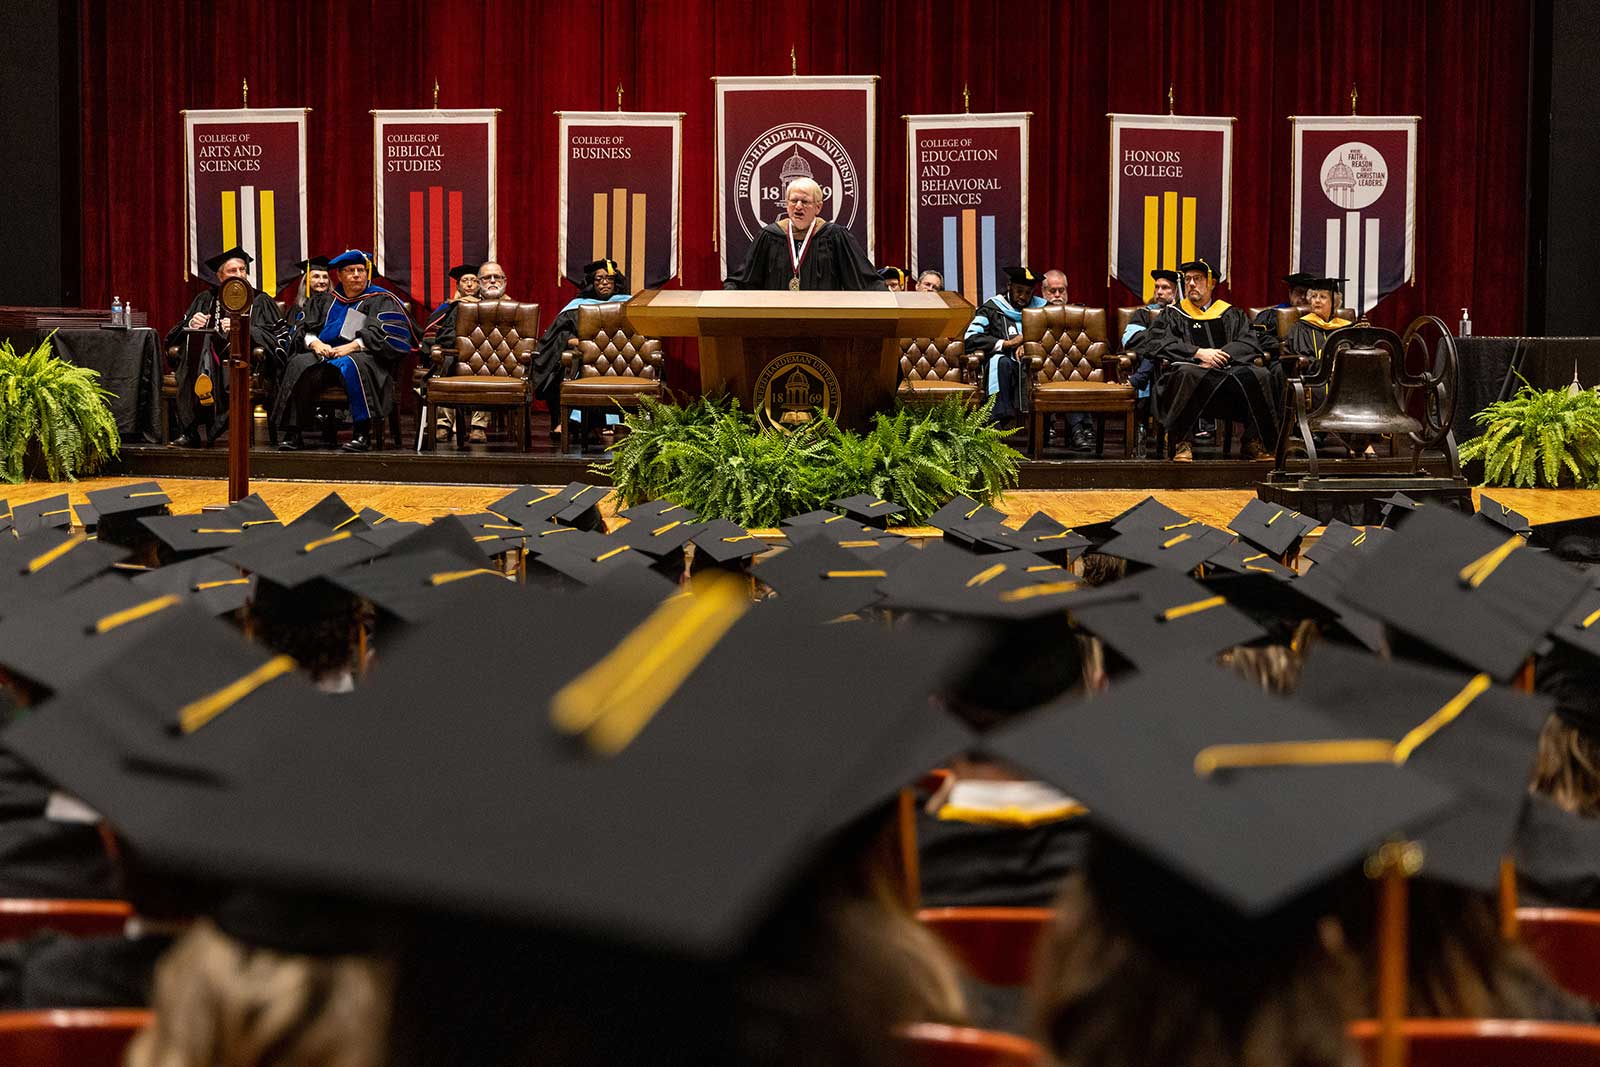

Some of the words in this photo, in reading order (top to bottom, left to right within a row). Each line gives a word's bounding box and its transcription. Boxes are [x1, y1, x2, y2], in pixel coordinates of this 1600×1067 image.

[199, 134, 238, 143] COLLEGE
[239, 134, 250, 142] OF
[387, 134, 427, 143] COLLEGE
[428, 134, 440, 142] OF
[572, 136, 611, 144] COLLEGE
[612, 136, 624, 144] OF
[920, 139, 959, 148] COLLEGE
[960, 138, 973, 147] OF
[200, 146, 231, 157] ARTS
[233, 145, 262, 157] AND
[388, 145, 445, 157] BIBLICAL
[572, 147, 632, 159] BUSINESS
[921, 149, 998, 162] EDUCATION
[1124, 150, 1181, 163] HONORS
[199, 160, 260, 172] SCIENCES
[387, 160, 441, 172] STUDIES
[739, 128, 815, 198] FREED-HARDEMAN
[816, 135, 854, 198] UNIVERSITY
[1351, 160, 1373, 168] REASON
[921, 164, 951, 177] AND
[1124, 164, 1183, 177] COLLEGE
[921, 178, 1002, 192] BEHAVIORAL
[761, 186, 780, 200] 18
[820, 185, 832, 201] 9
[921, 193, 982, 206] SCIENCES
[771, 392, 784, 403] 18
[808, 393, 822, 404] 69
